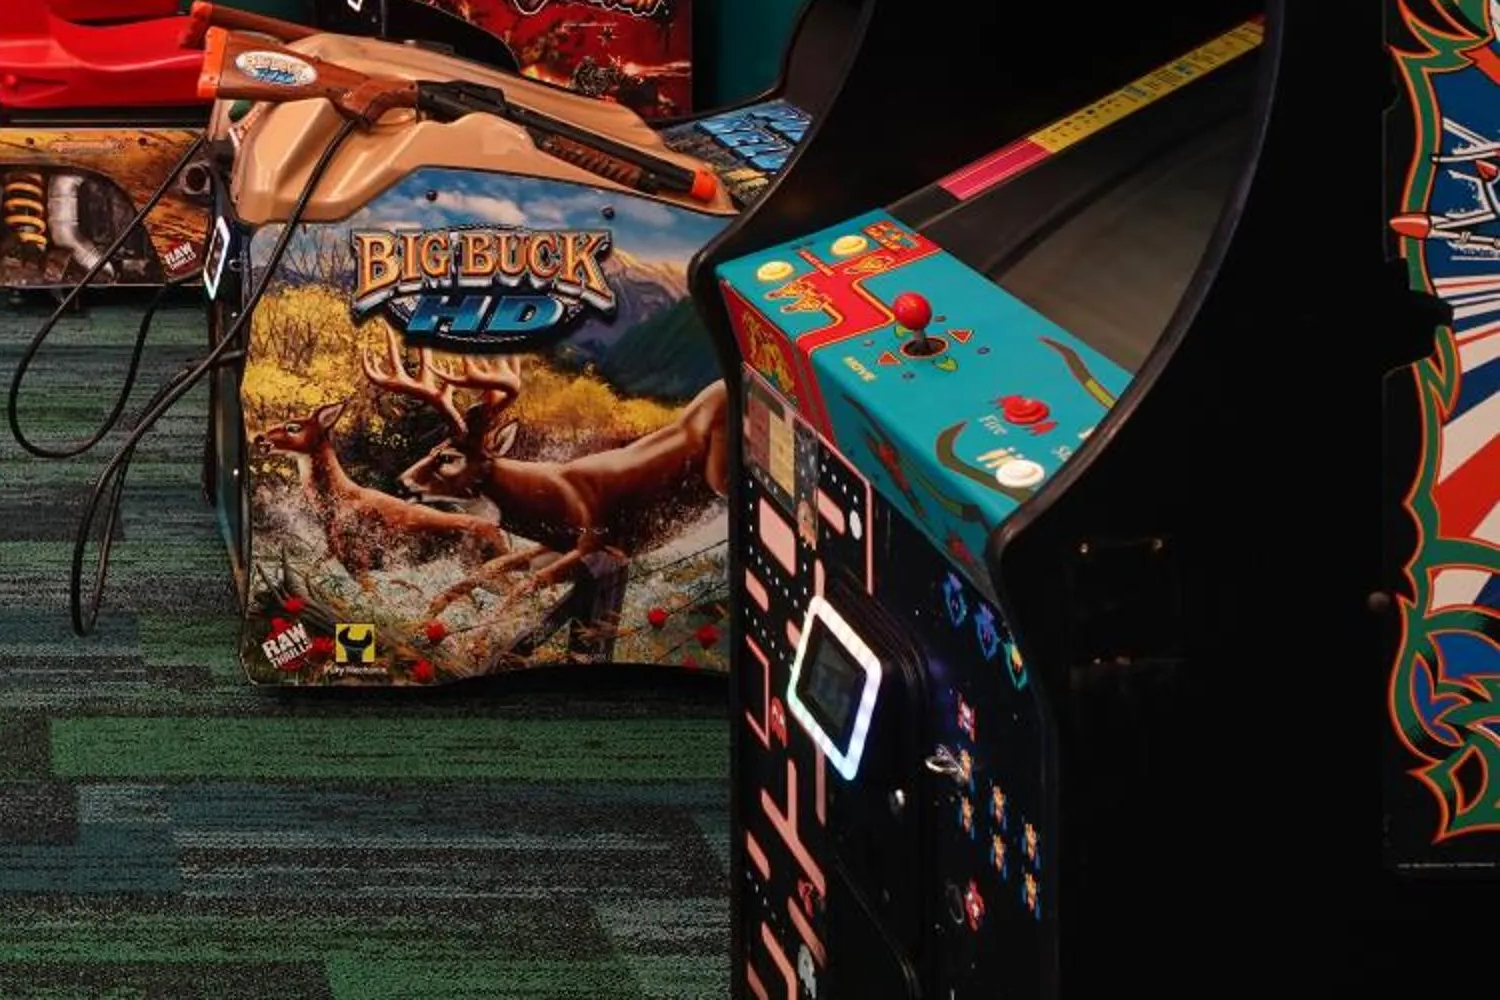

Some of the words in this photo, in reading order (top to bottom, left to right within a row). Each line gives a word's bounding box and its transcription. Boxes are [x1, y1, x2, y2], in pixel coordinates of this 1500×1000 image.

[353, 230, 453, 302] BIG
[459, 229, 614, 301] BUCK
[406, 294, 564, 332] HD
